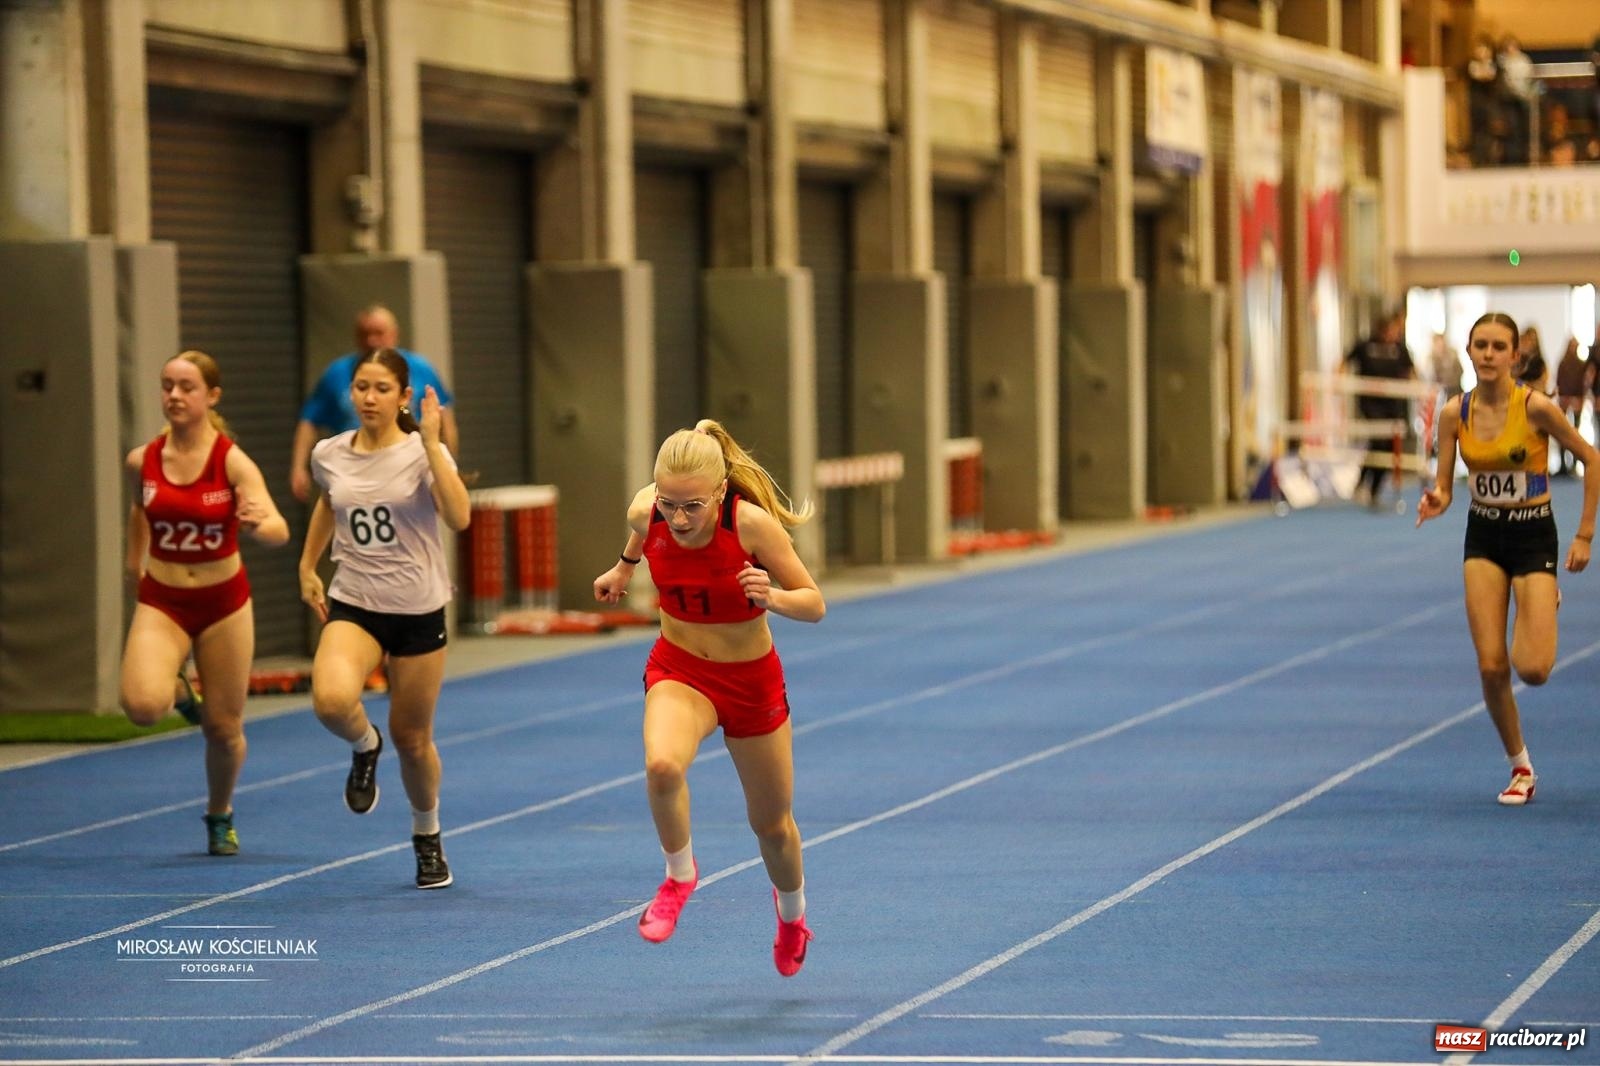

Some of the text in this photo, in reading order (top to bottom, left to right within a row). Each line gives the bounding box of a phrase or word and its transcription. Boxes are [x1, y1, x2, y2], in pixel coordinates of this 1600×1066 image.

[1475, 472, 1517, 498] 604
[350, 505, 396, 546] 68
[1471, 502, 1551, 521] PRO NIKE
[153, 520, 224, 551] 225
